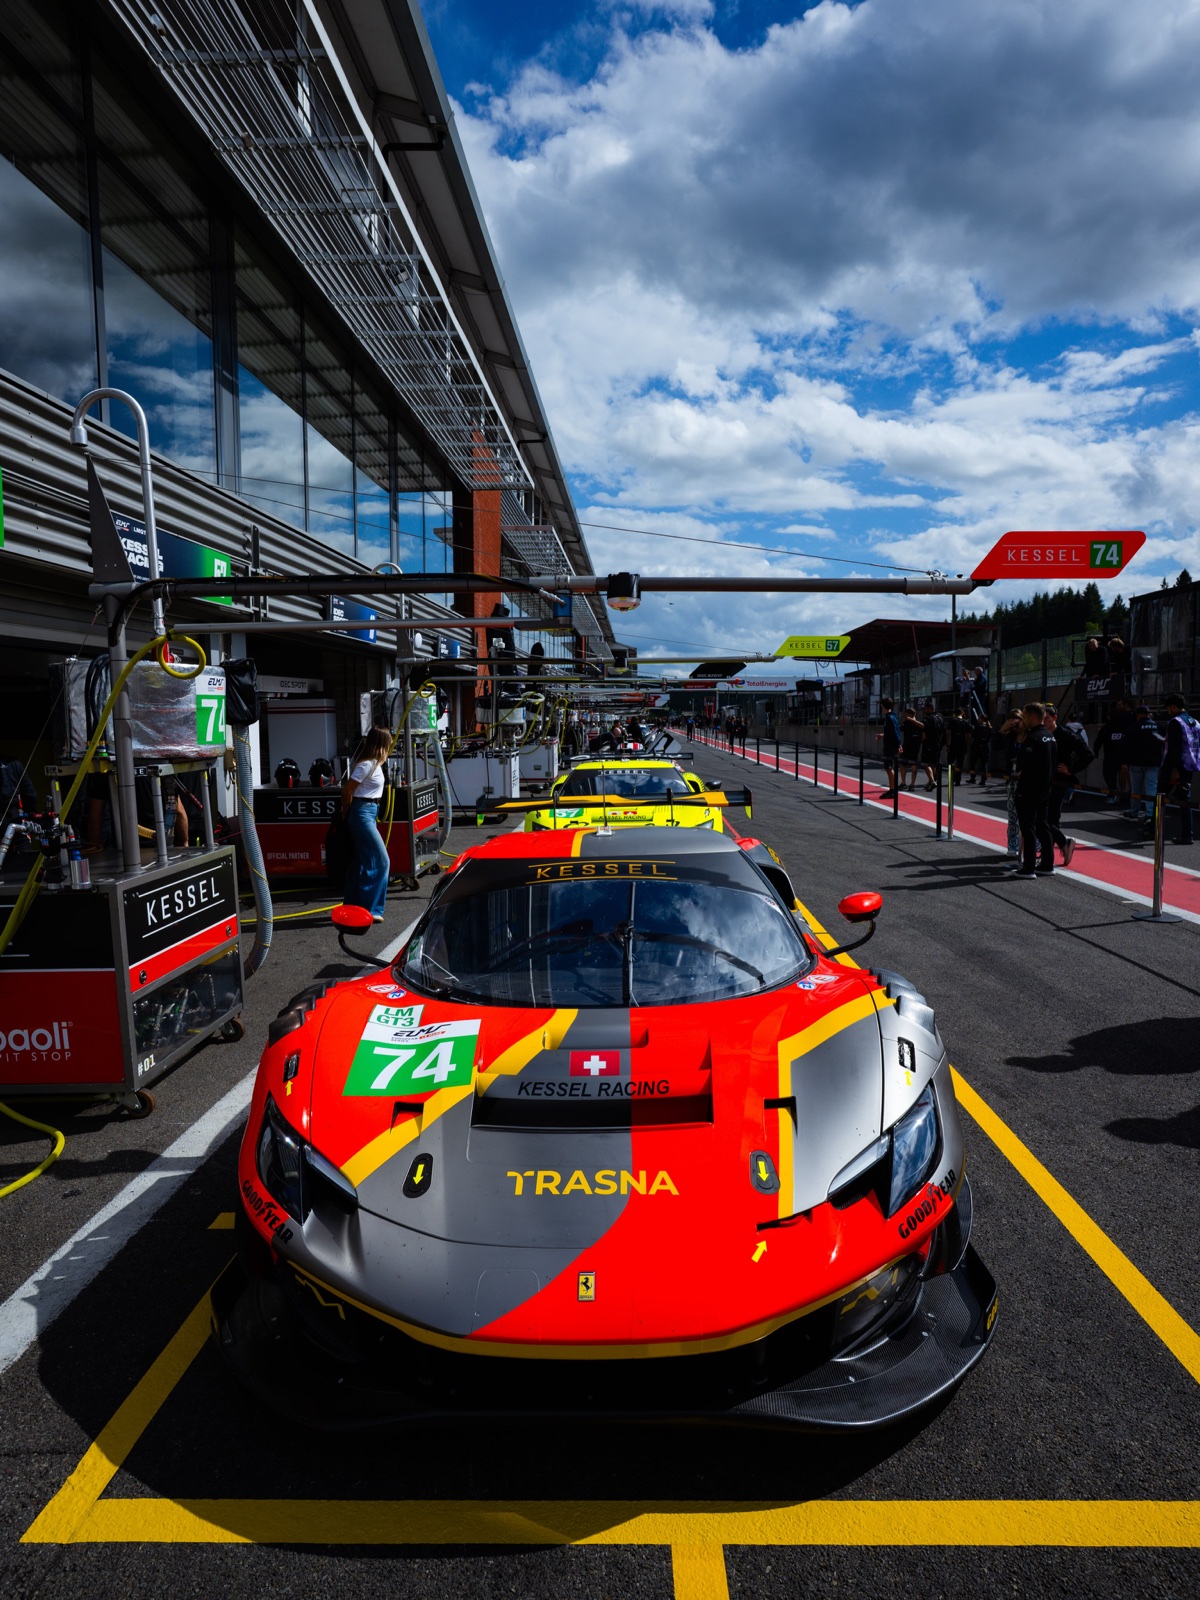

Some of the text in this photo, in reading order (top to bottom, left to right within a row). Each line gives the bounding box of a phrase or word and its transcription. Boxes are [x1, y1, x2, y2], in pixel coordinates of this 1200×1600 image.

[133, 527, 147, 535] LMGT
[119, 536, 163, 561] KESSL
[1007, 544, 1119, 565] KESSEL 74
[826, 640, 839, 651] 57
[747, 680, 787, 688] TotalEnergies
[283, 800, 336, 815] KESS
[416, 792, 434, 808] KESSEL
[266, 852, 310, 861] OFFICIAL PARTNER
[536, 863, 667, 879] KESSEL
[146, 876, 221, 927] KESSEL
[384, 1007, 414, 1017] LM
[376, 1014, 415, 1027] GT3
[31, 1051, 72, 1062] STOP
[137, 1053, 157, 1077] #01
[369, 1040, 457, 1090] 74
[518, 1080, 670, 1097] KESSEL RACING
[506, 1169, 680, 1196] TRASNA
[242, 1179, 294, 1245] GOODYEAR
[897, 1168, 957, 1240] GOODYEAR
